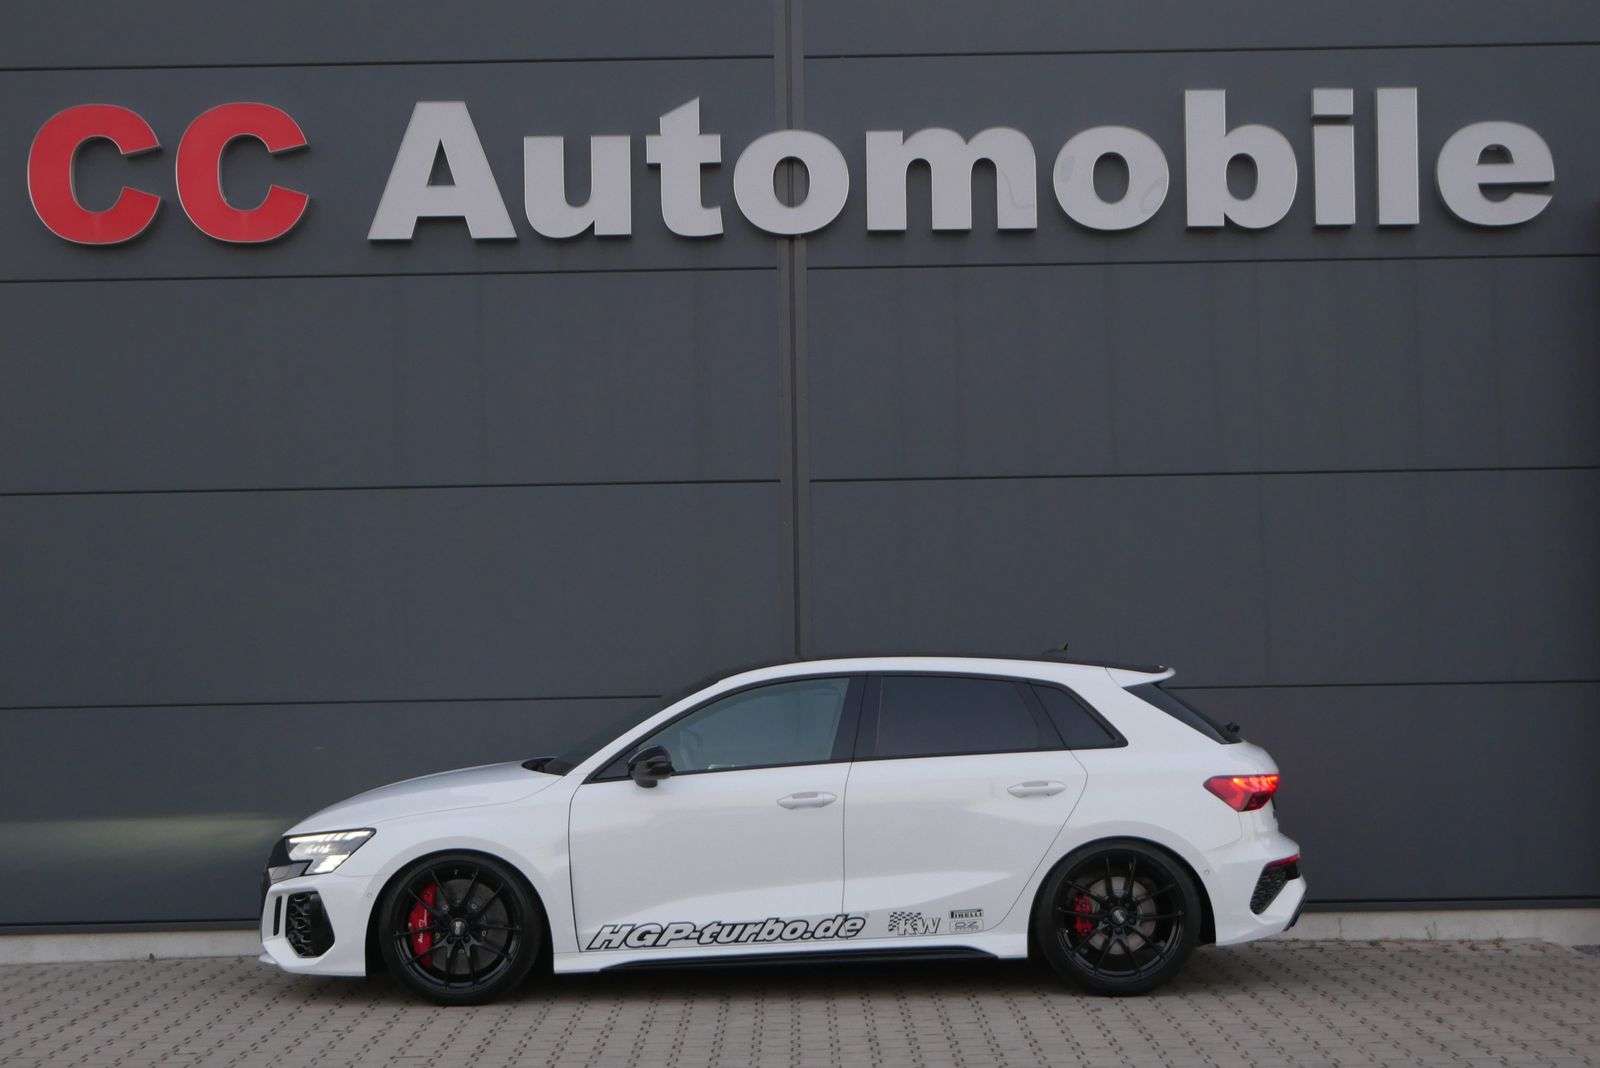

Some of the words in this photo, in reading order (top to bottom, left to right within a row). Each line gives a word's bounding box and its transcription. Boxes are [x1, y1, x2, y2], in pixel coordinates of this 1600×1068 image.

[27, 101, 309, 246] CC
[367, 87, 1556, 242] Automobile
[586, 913, 867, 951] HGP-turbo.de
